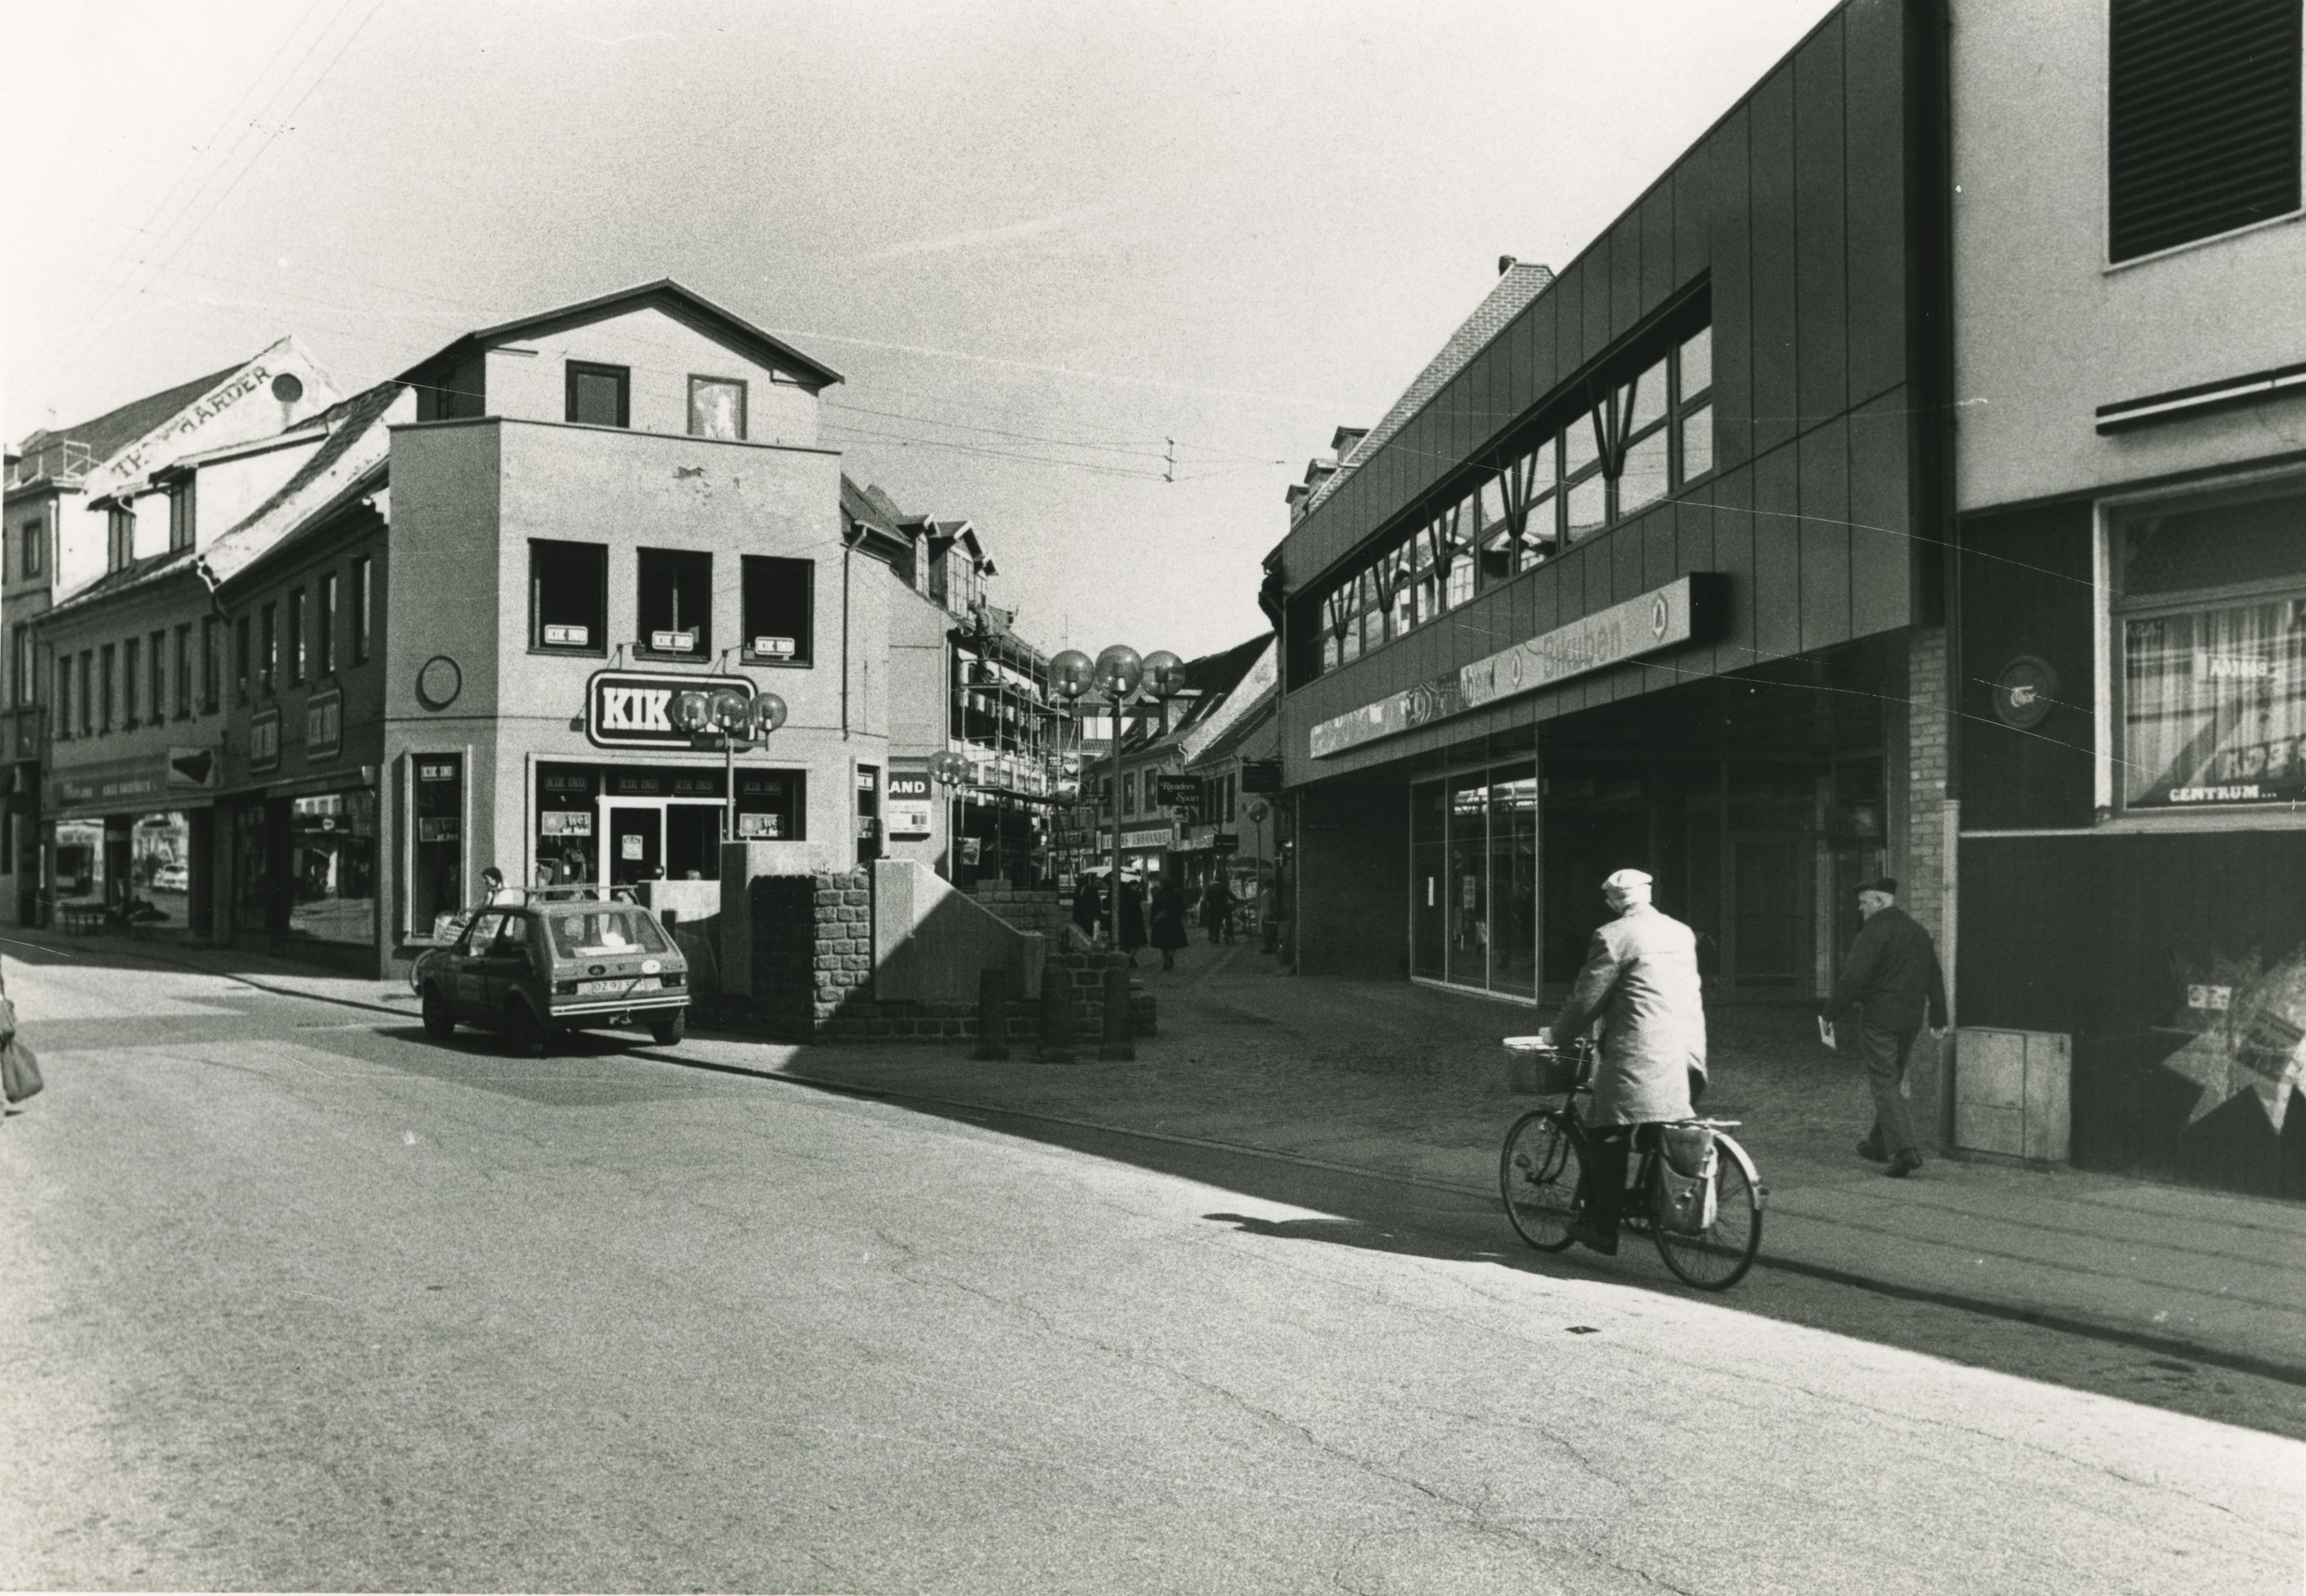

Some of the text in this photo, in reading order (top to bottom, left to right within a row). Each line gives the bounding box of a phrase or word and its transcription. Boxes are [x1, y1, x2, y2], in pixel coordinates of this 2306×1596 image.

[602, 687, 672, 731] KIK
[547, 777, 585, 787] KIK IND
[621, 779, 637, 789] KIK
[677, 780, 692, 790] KIK
[744, 781, 761, 792] KIK
[1160, 782, 1196, 792] Randers
[1176, 792, 1199, 803] Sport
